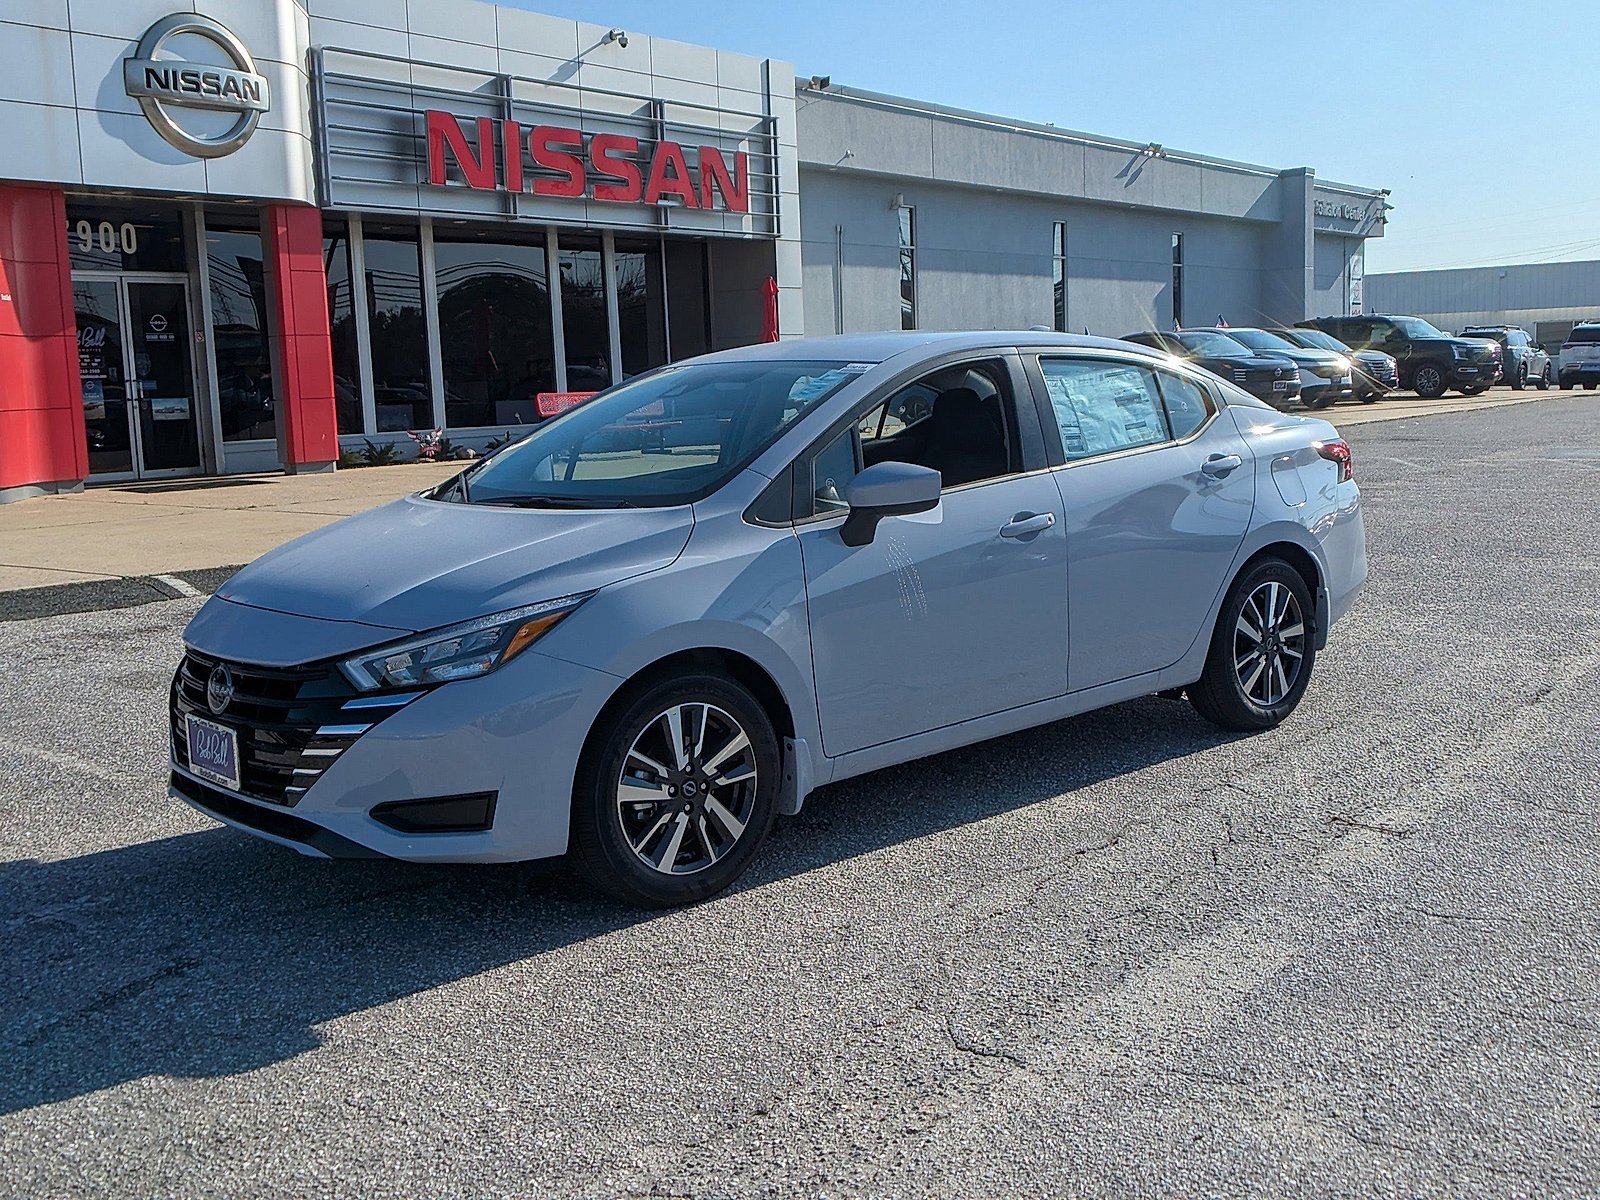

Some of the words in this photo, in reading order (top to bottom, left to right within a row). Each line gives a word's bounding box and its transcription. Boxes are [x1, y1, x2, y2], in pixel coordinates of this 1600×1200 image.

[144, 66, 261, 104] NISSAN
[425, 109, 749, 213] NISSAN
[1344, 203, 1366, 221] Center
[65, 219, 137, 255] 900
